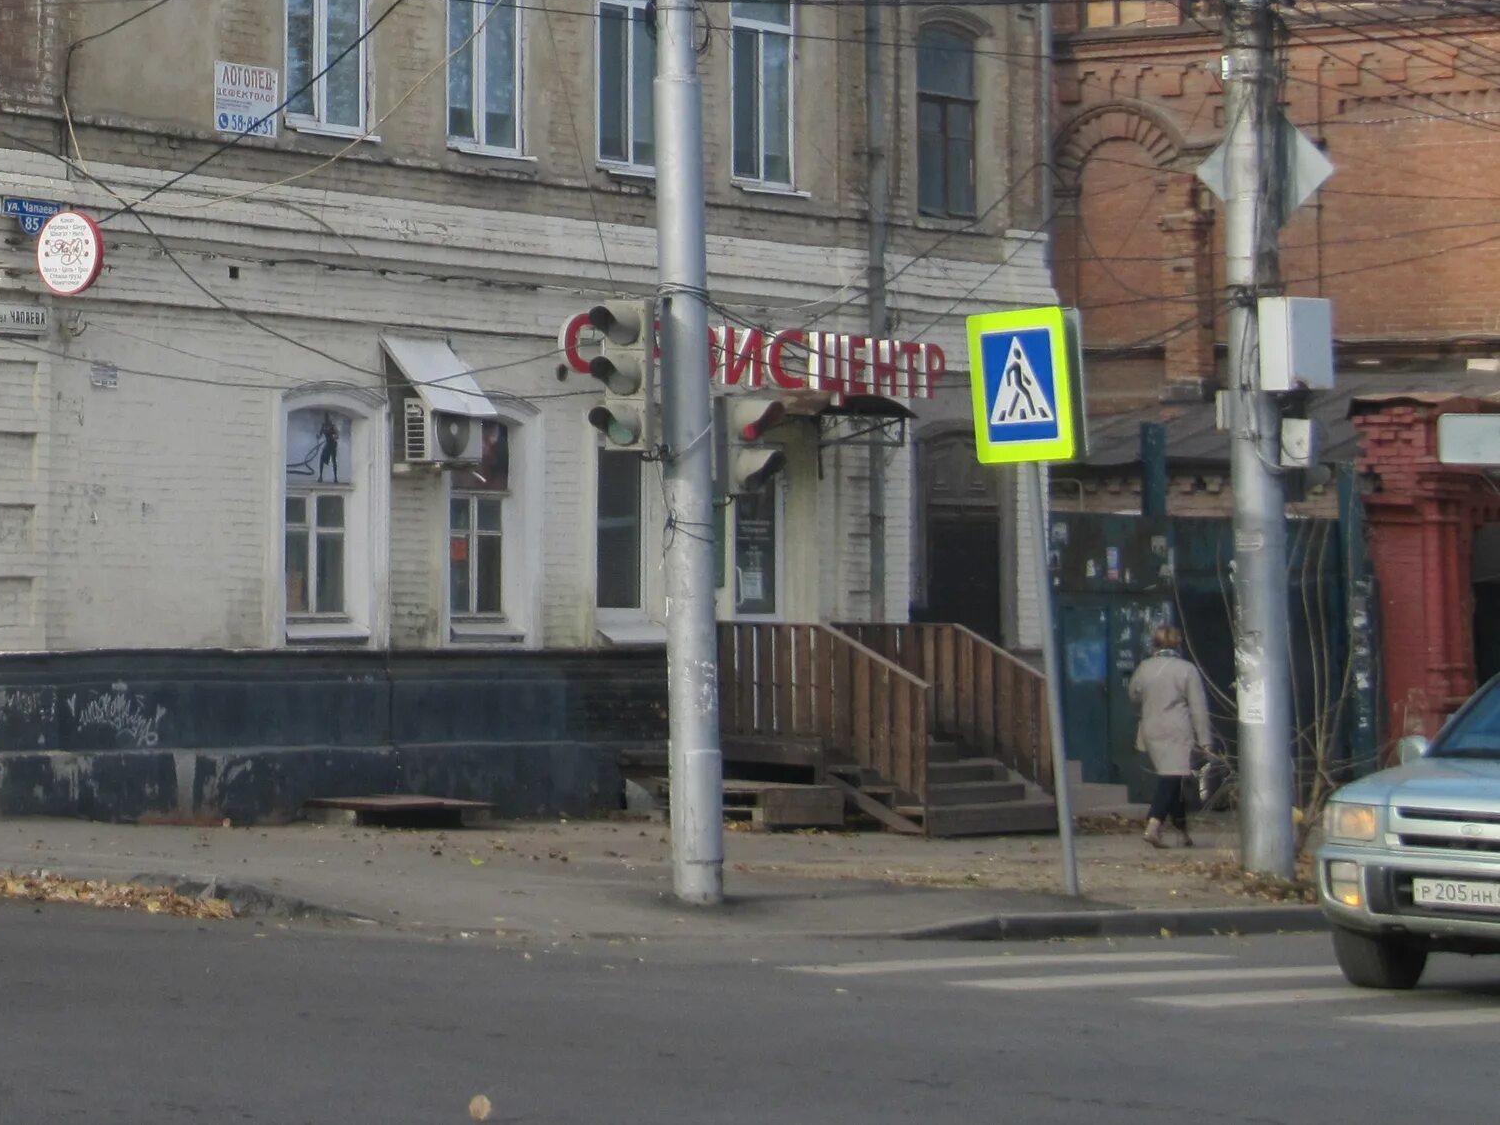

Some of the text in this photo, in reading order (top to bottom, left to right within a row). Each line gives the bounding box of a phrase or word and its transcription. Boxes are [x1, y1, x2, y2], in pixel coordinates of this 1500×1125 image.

[216, 87, 275, 103] ДЕФЕКТОЛОГ
[6, 201, 58, 214] ул. Чапаева
[25, 216, 39, 231] 85
[10, 310, 46, 325] ЧАПАЕВА
